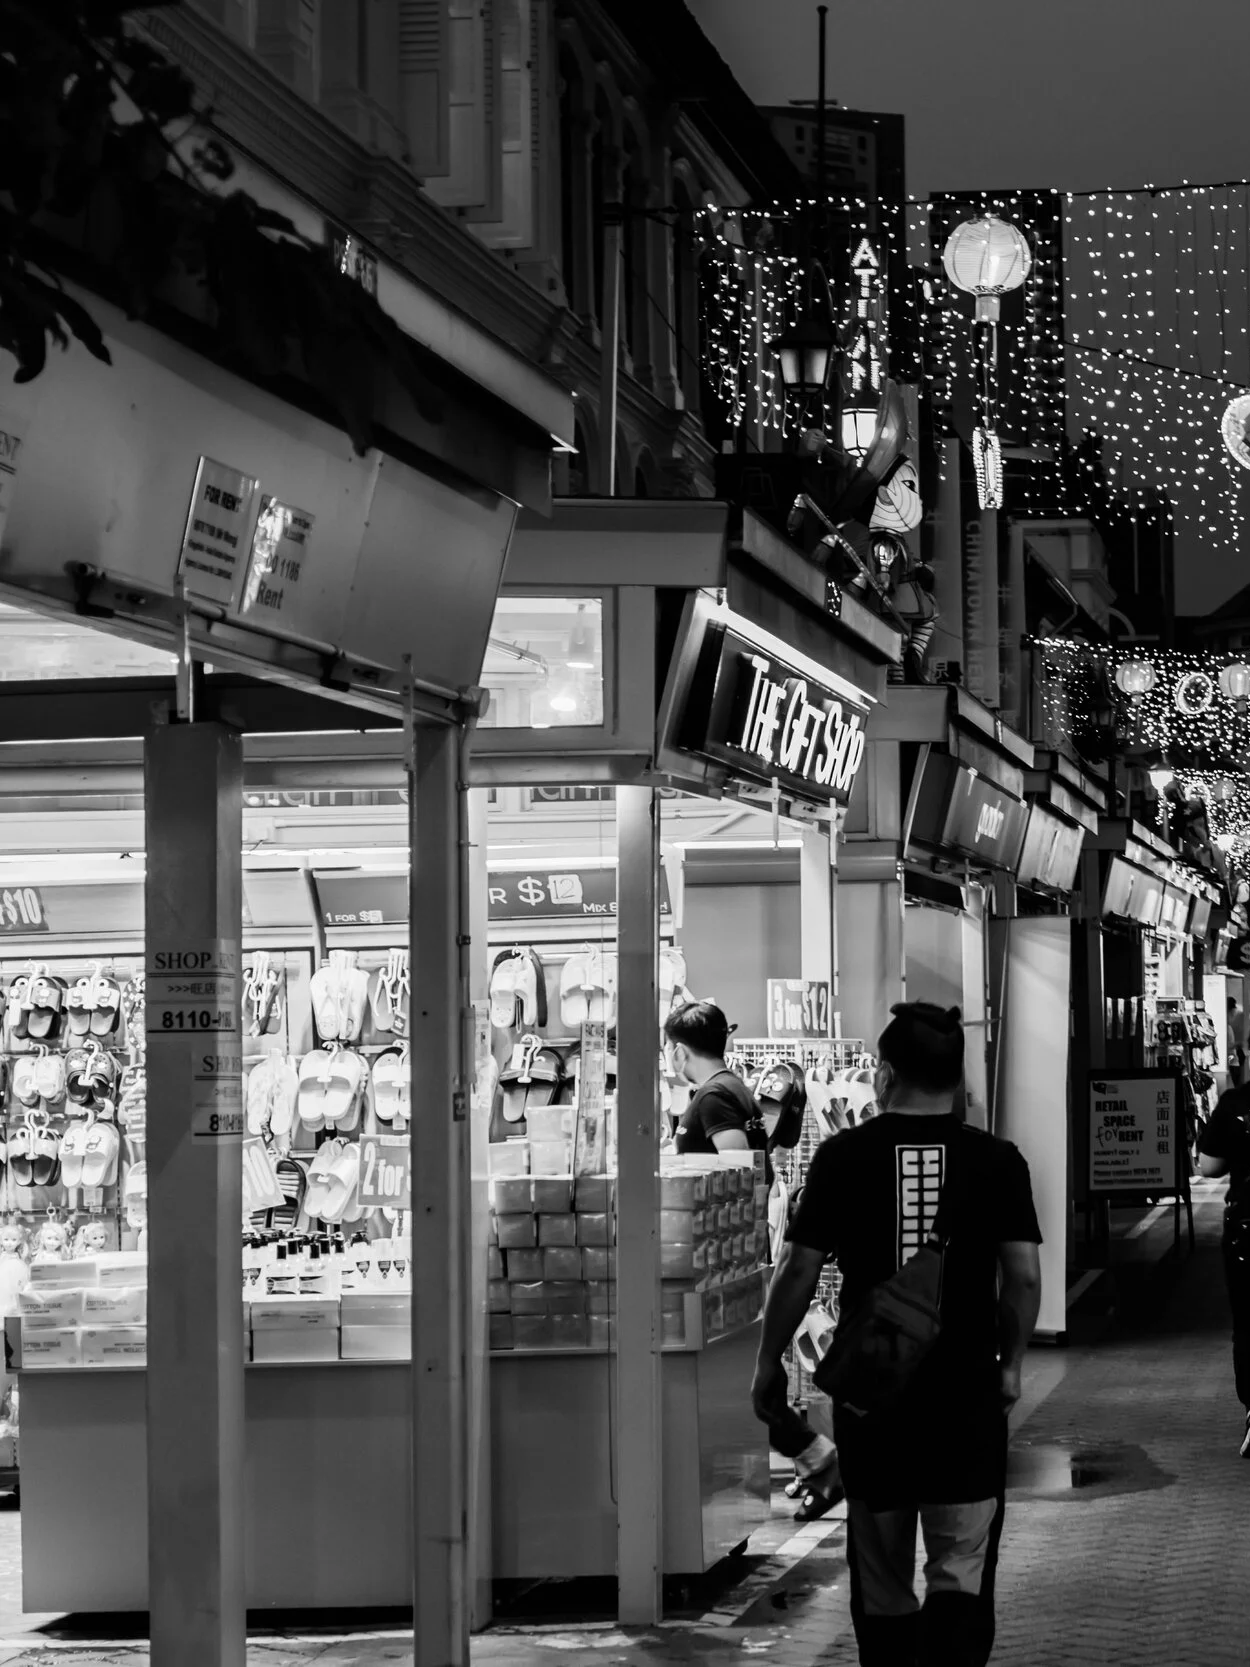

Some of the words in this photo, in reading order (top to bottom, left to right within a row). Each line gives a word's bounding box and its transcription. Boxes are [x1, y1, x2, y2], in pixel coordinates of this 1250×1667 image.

[257, 579, 284, 610] Rent
[741, 654, 787, 762] THE
[815, 701, 865, 792] SHOP
[583, 902, 607, 914] MIX
[335, 914, 357, 922] FOR
[154, 952, 212, 969] SHOP
[774, 985, 784, 1031] 3
[1095, 1100, 1128, 1112] RETAIL
[1103, 1115, 1136, 1127] SPACE
[1118, 1130, 1144, 1142] RENT
[363, 1141, 376, 1196] 2
[378, 1158, 404, 1196] for
